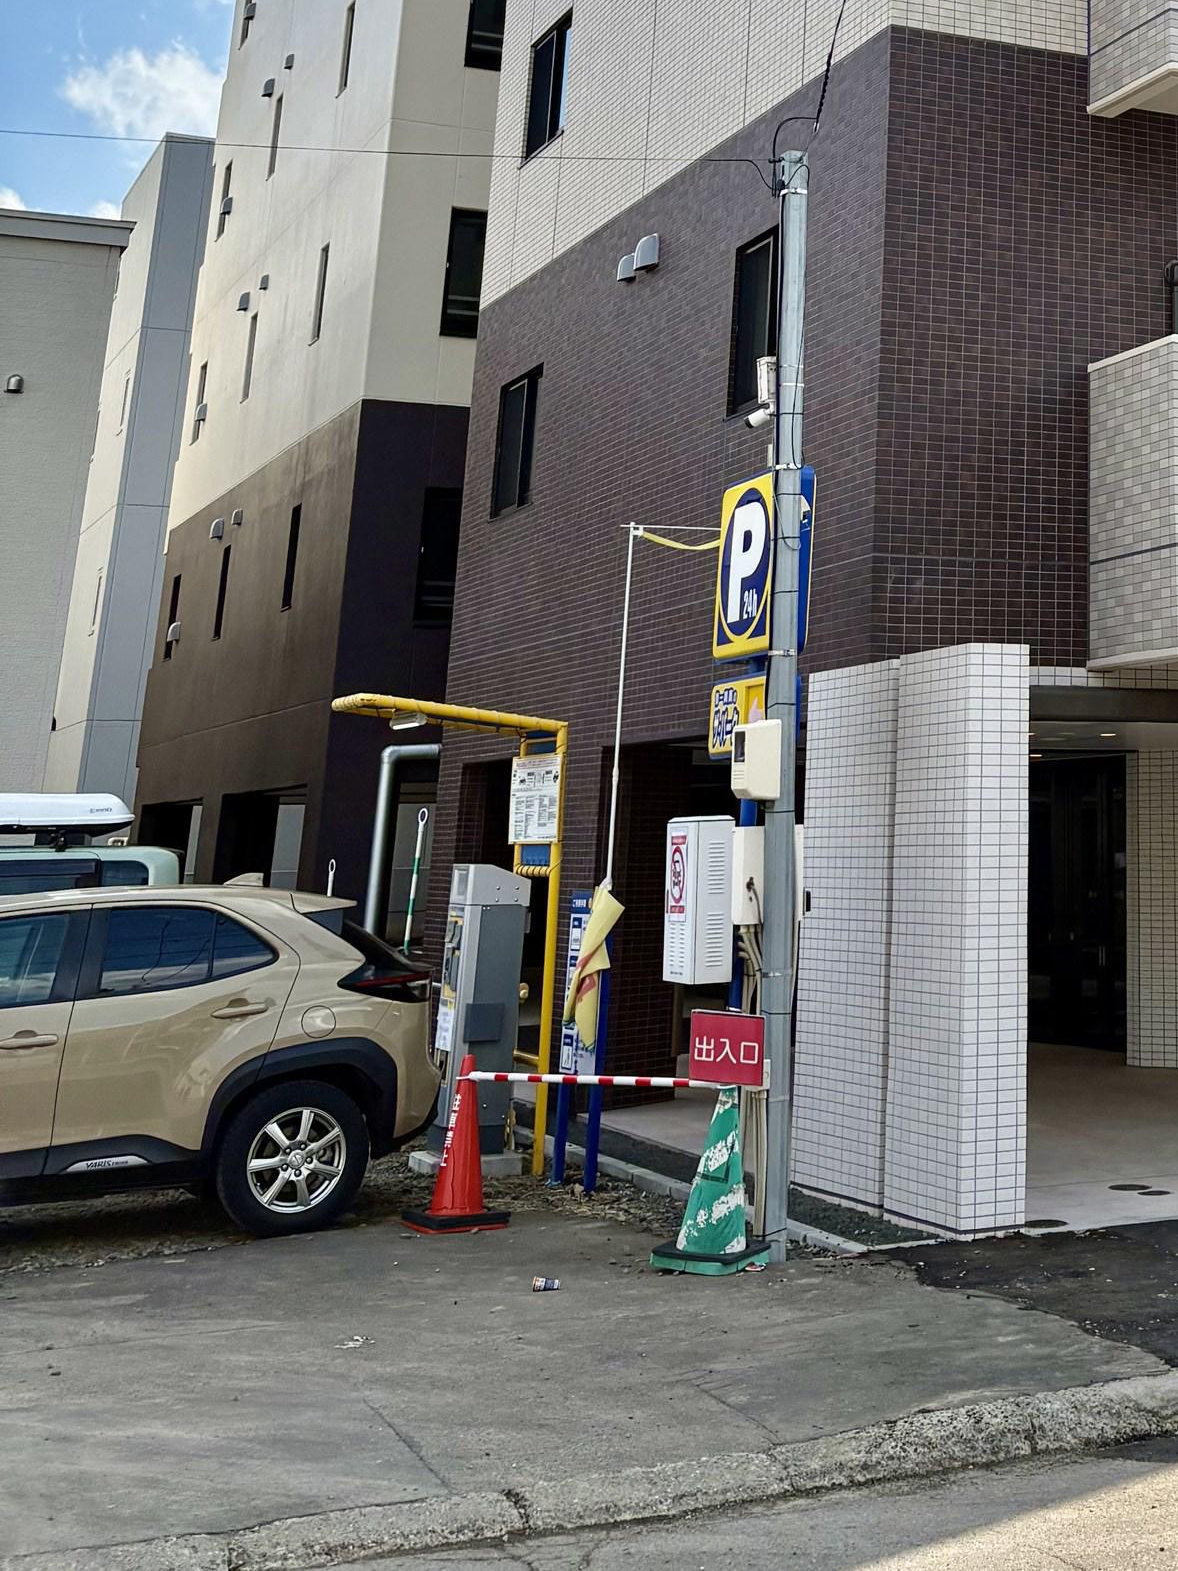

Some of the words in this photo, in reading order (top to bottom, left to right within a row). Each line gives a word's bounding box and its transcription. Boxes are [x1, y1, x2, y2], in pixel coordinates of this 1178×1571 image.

[726, 501, 767, 624] P
[743, 589, 758, 620] 24h
[694, 1035, 759, 1065] 出入口
[86, 1159, 112, 1168] YARIS
